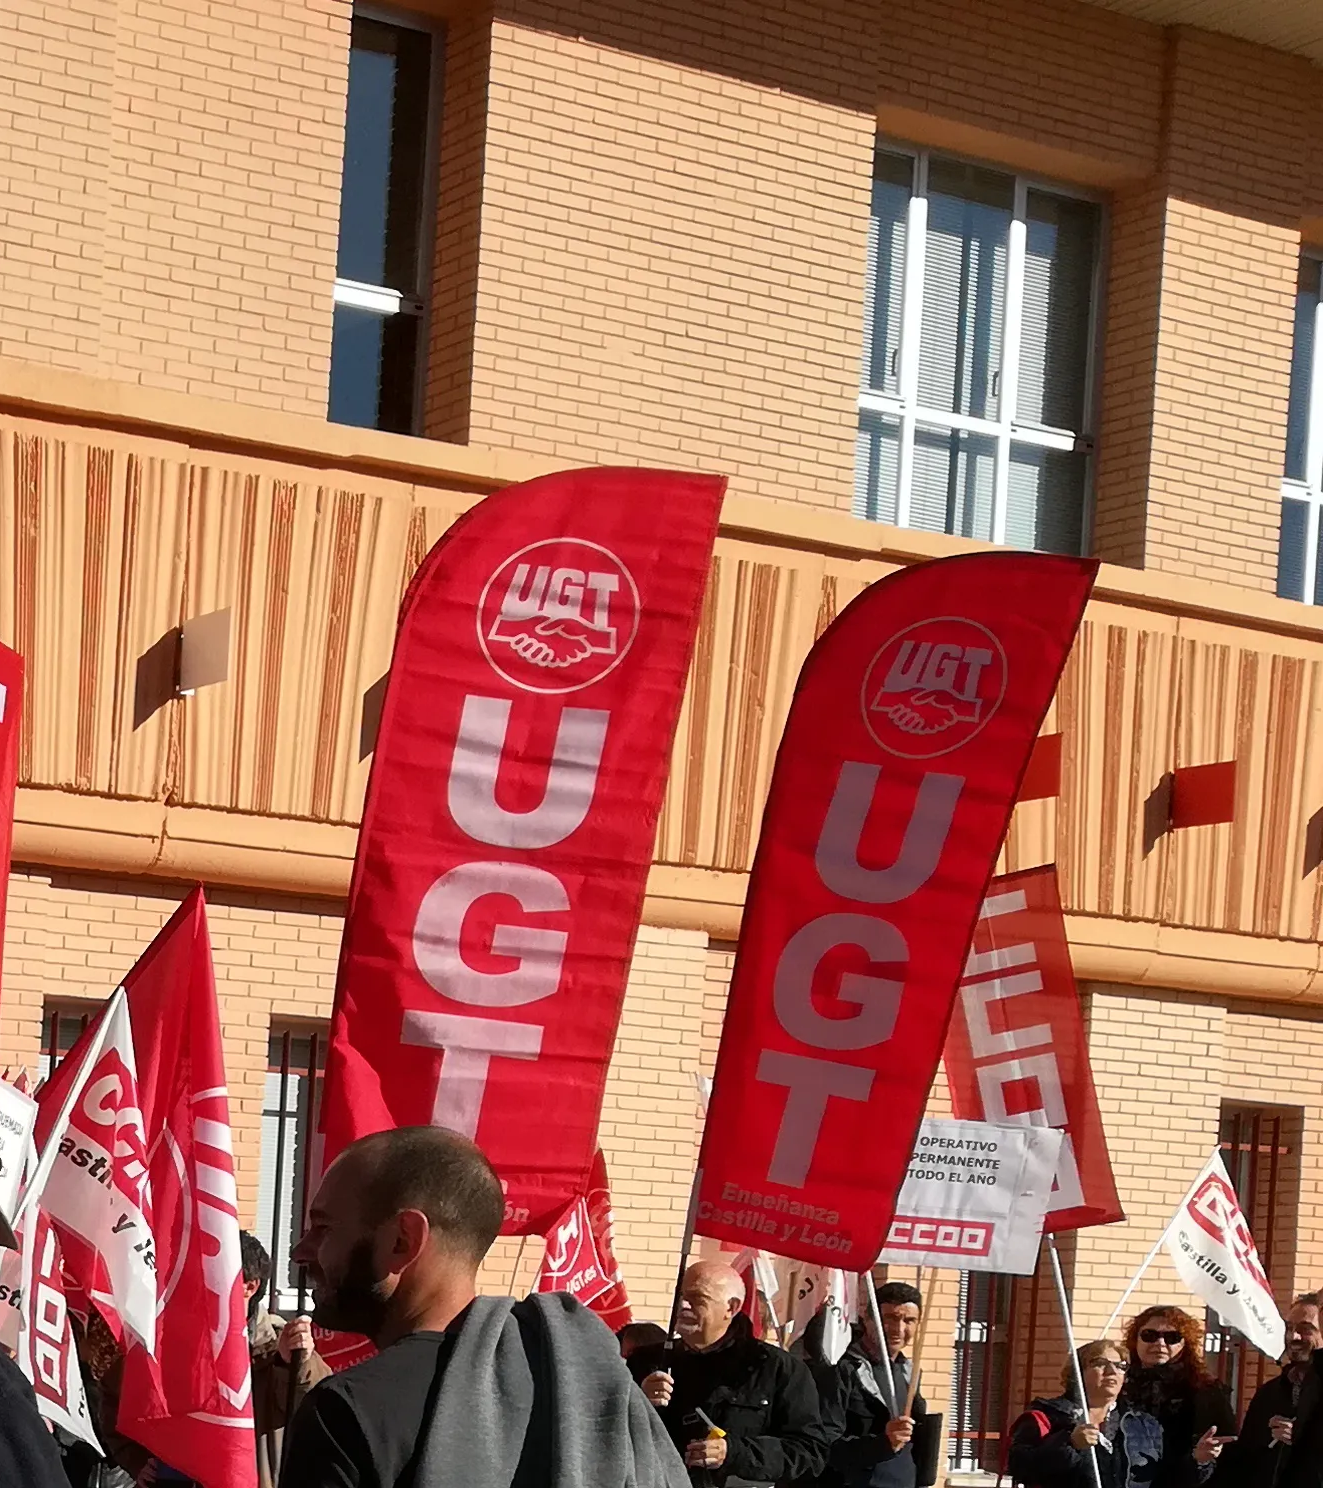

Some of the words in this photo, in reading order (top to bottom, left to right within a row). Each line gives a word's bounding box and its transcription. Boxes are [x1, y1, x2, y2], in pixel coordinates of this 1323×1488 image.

[501, 563, 620, 632] UGT
[883, 640, 994, 704] UGT
[400, 694, 608, 1142] UGT
[755, 761, 967, 1190] UGT
[911, 1152, 1001, 1170] PERMANENTE
[920, 1136, 998, 1153] OPERATIVO
[907, 1168, 945, 1182] TODO
[948, 1173, 964, 1183] EL
[967, 1172, 997, 1186] AÑO
[721, 1181, 841, 1226] Enseñanza
[696, 1200, 778, 1235] Castilla
[780, 1222, 798, 1242] y
[798, 1224, 854, 1254] León
[886, 1221, 987, 1250] CCOO
[1226, 1283, 1240, 1295] y
